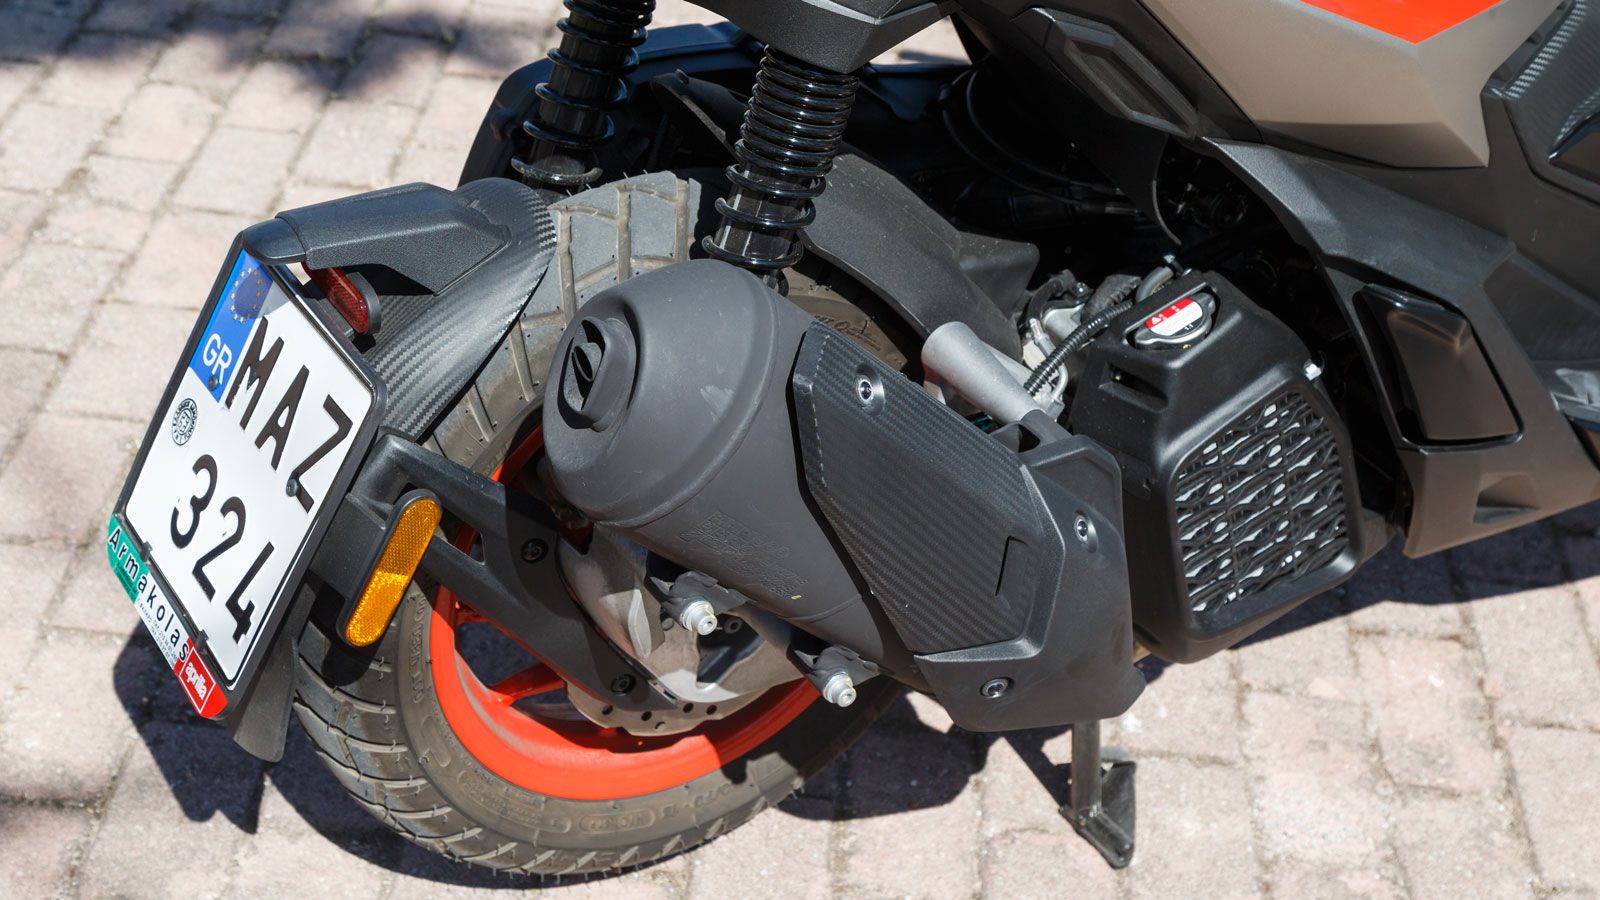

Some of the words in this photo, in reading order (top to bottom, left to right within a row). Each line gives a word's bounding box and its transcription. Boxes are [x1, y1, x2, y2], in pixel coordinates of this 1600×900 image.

[203, 333, 232, 384] GR
[225, 316, 353, 513] MAZ
[109, 528, 188, 660] Armakolas
[170, 454, 275, 644] 324
[185, 662, 207, 700] aprilia
